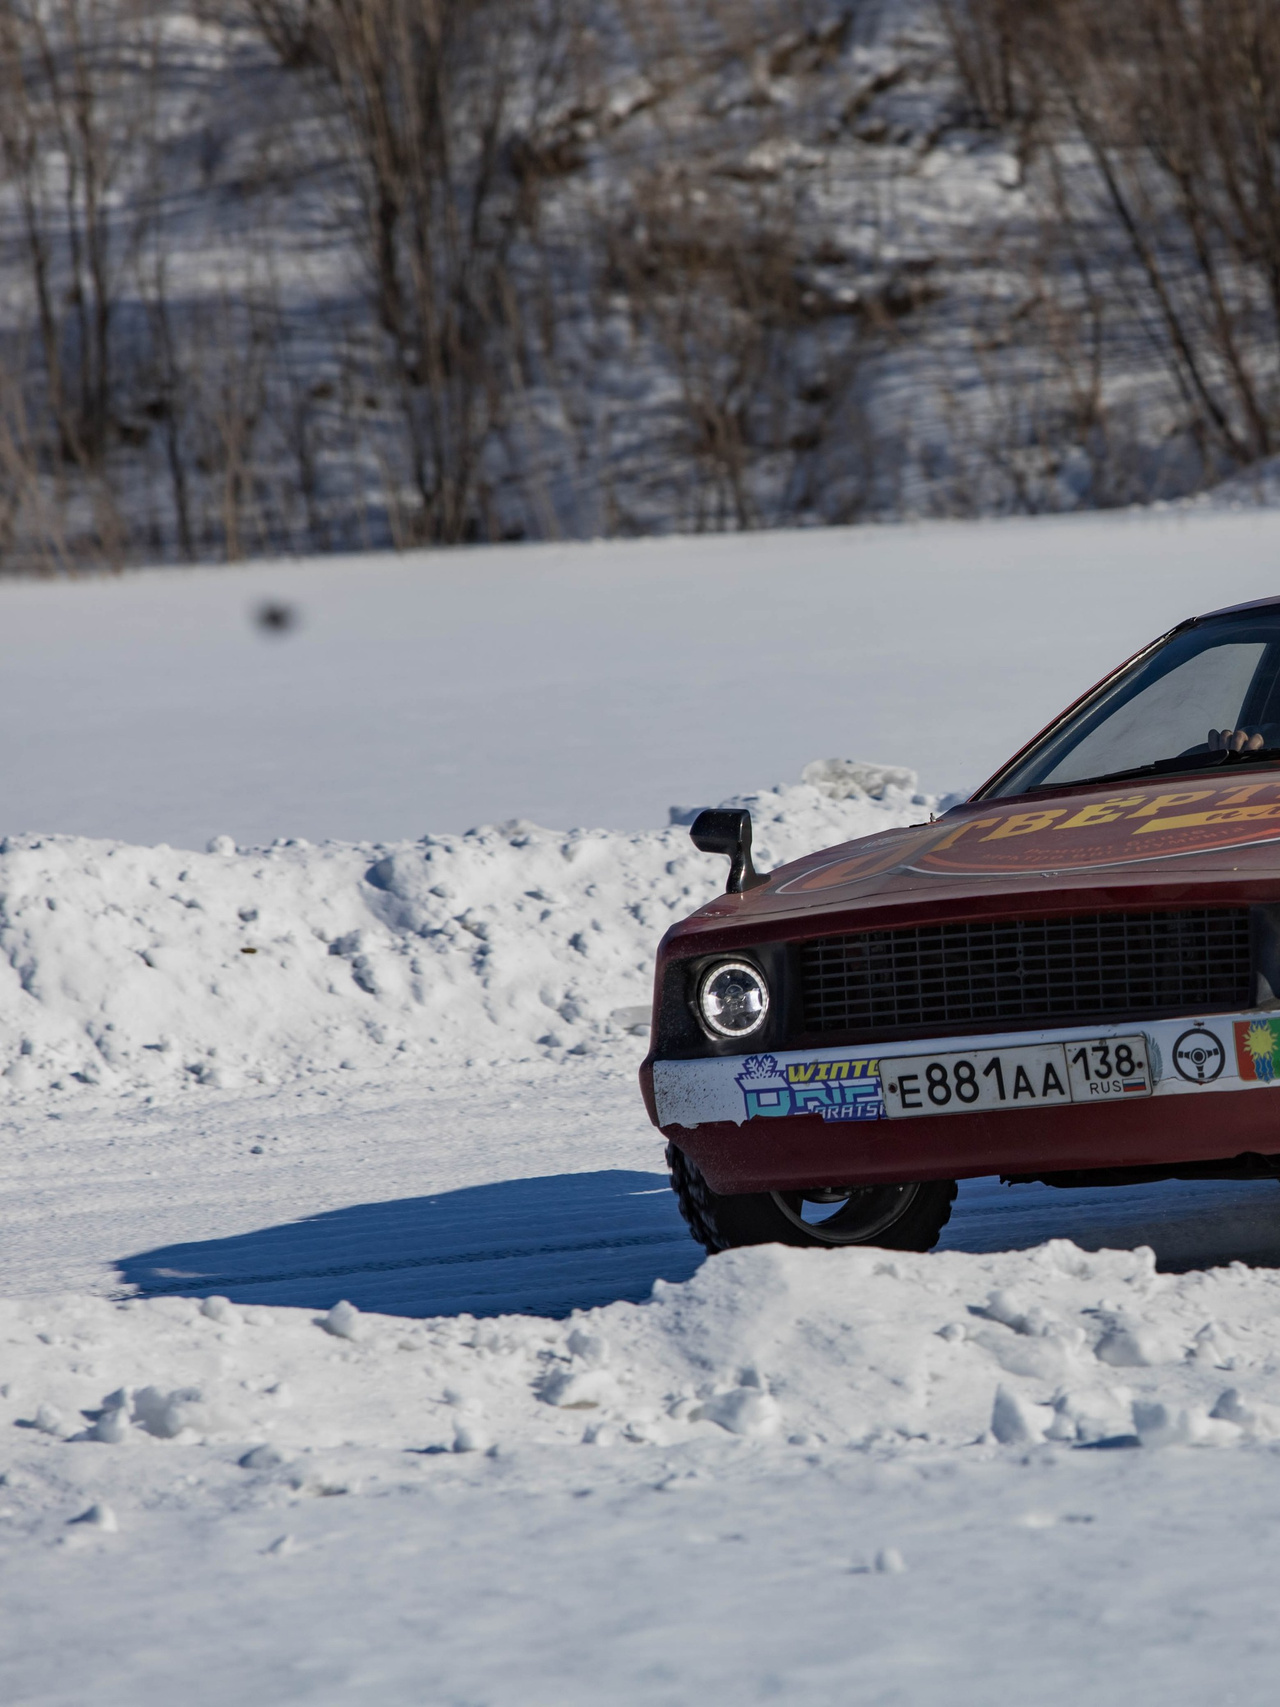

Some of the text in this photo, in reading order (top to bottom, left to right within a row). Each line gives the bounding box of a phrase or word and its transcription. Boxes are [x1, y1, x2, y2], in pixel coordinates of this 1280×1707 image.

[1071, 1044, 1136, 1081] 138
[897, 1057, 1065, 1109] E881AA
[1089, 1080, 1122, 1095] RUS
[813, 1102, 887, 1120] RATS
